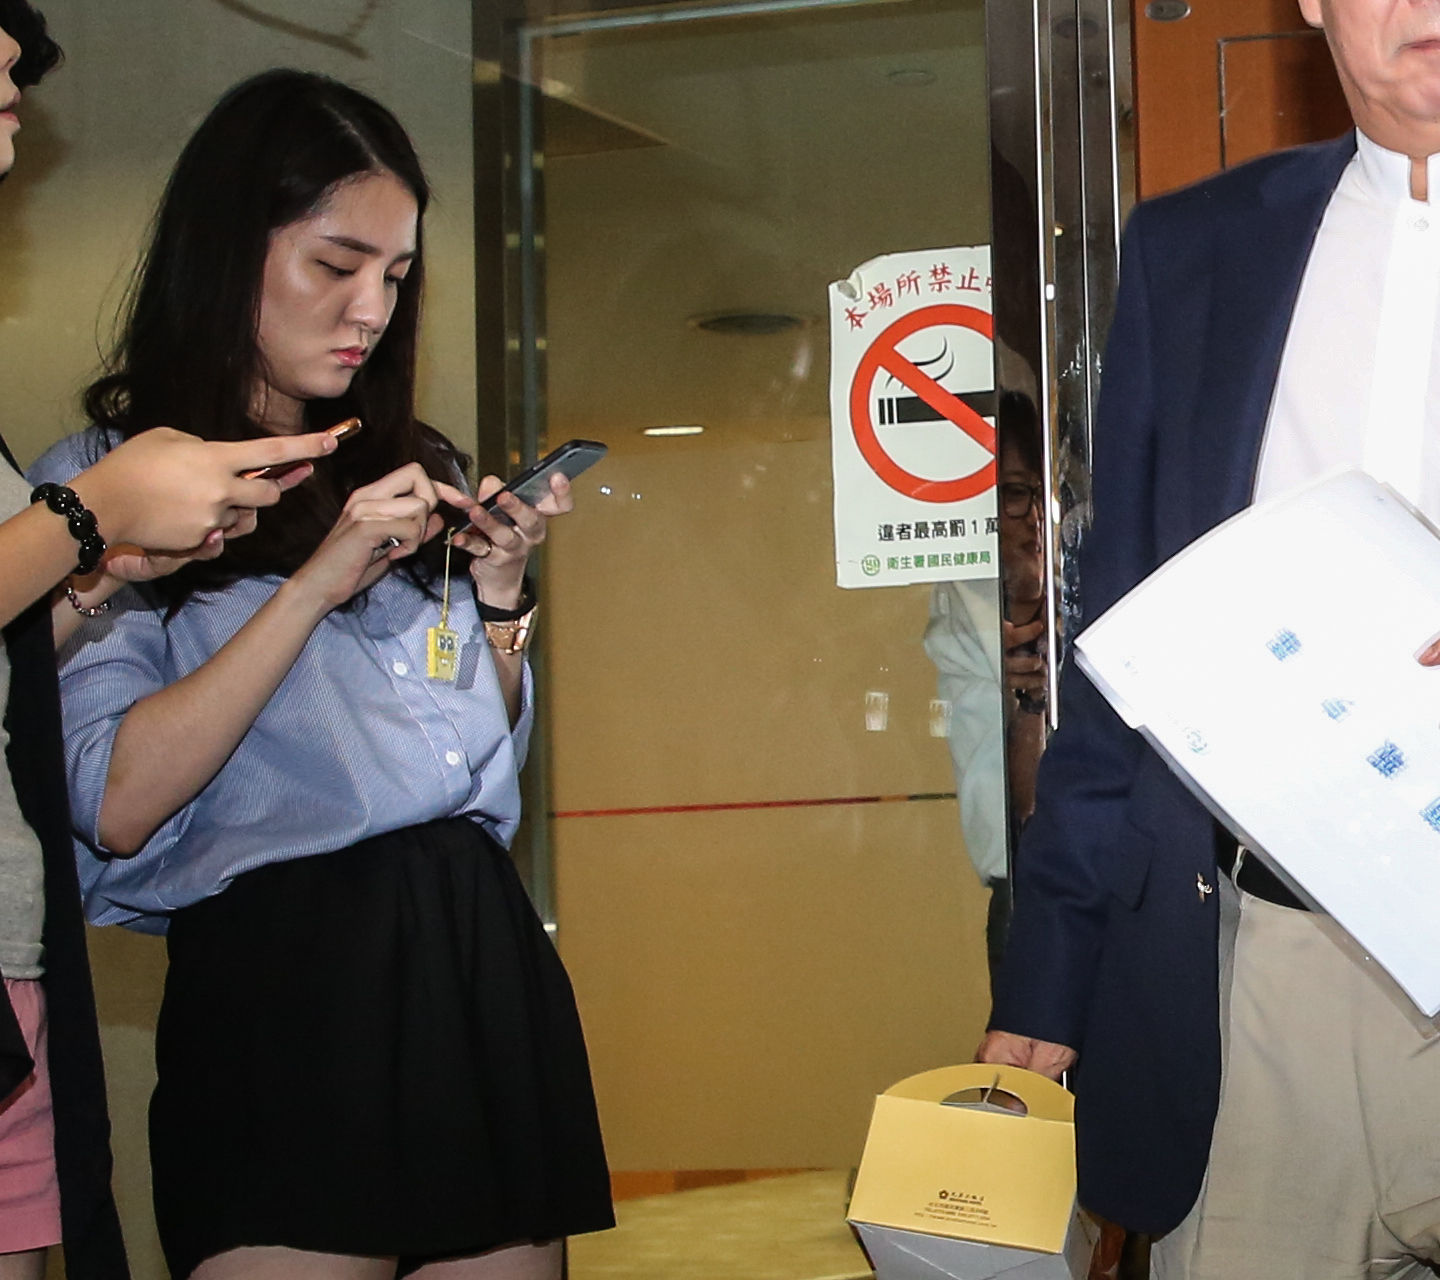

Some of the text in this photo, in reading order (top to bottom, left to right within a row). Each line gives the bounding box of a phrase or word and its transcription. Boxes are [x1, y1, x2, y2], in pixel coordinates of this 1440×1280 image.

[844, 262, 993, 332] 本場所禁止
[887, 551, 991, 570] 衛生署國民健康局
